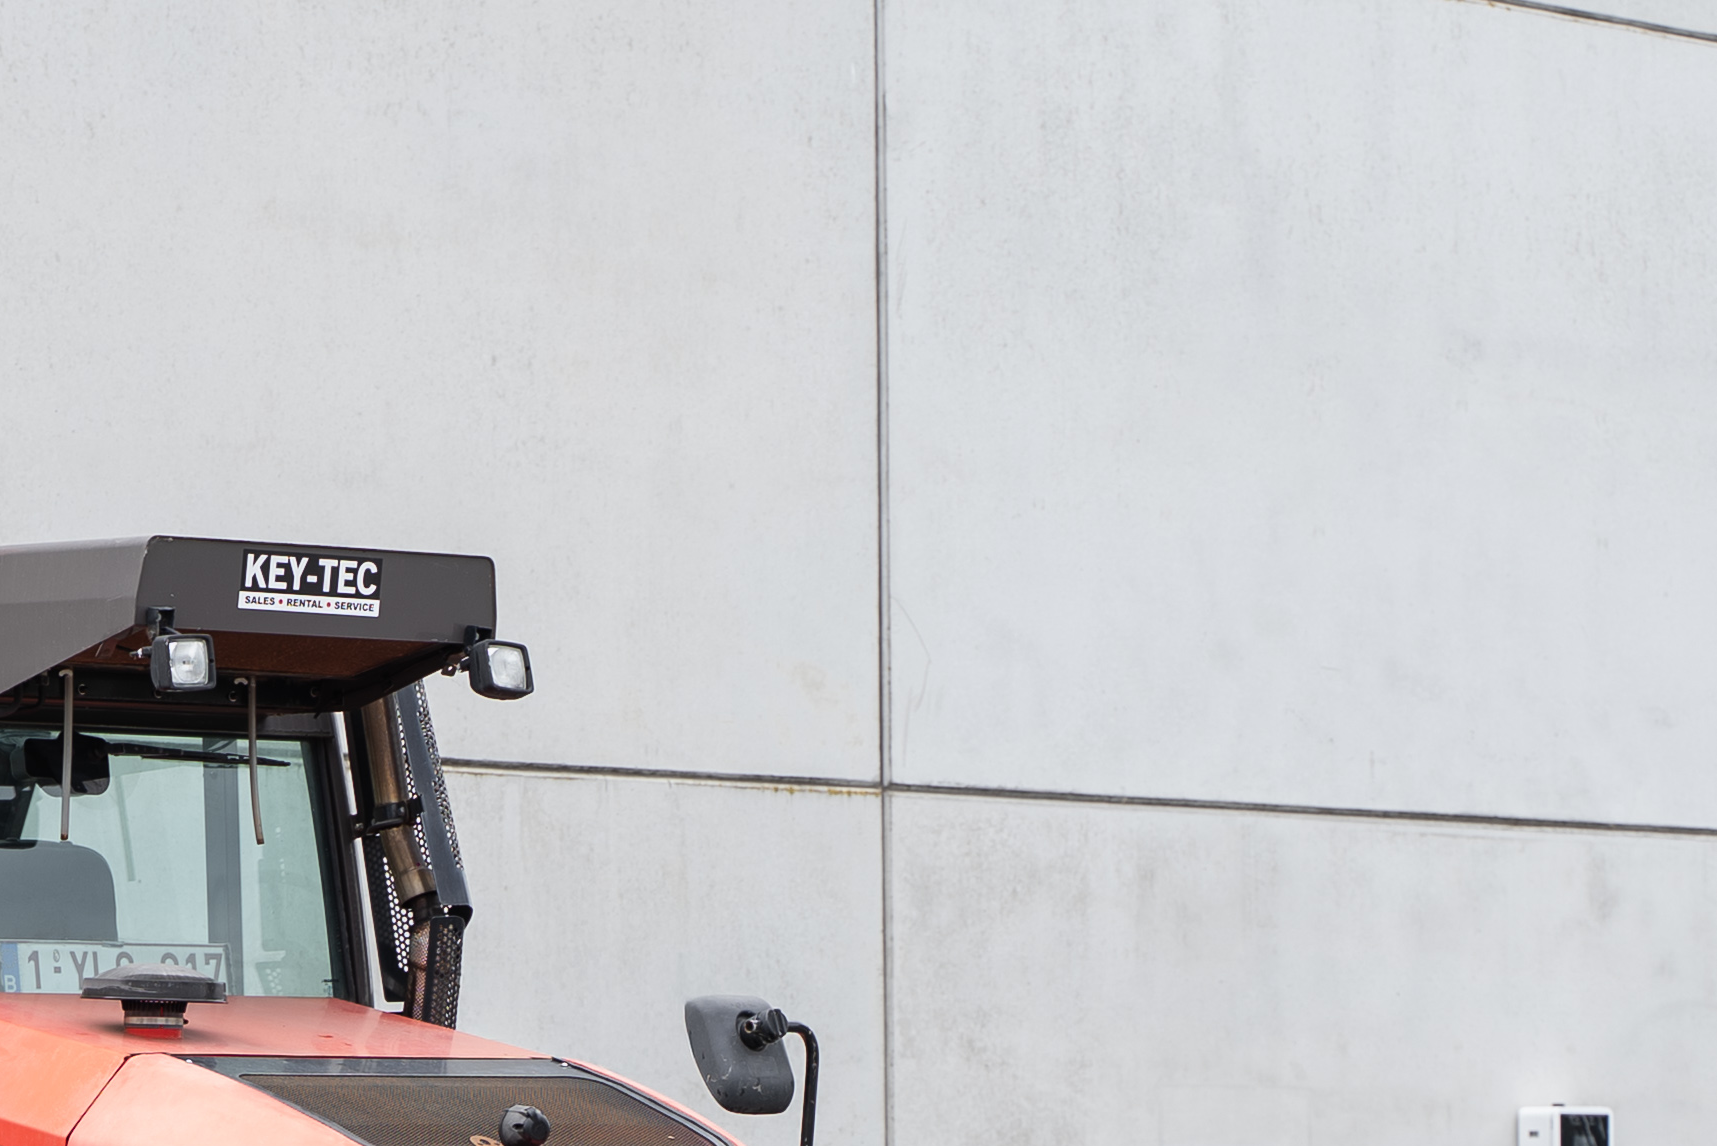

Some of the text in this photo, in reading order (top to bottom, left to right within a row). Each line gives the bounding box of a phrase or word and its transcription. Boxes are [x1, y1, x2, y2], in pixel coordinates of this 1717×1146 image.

[244, 553, 378, 596] KEY-TEC
[244, 595, 375, 613] SALES RENTAL SERVICE
[4, 975, 17, 993] B
